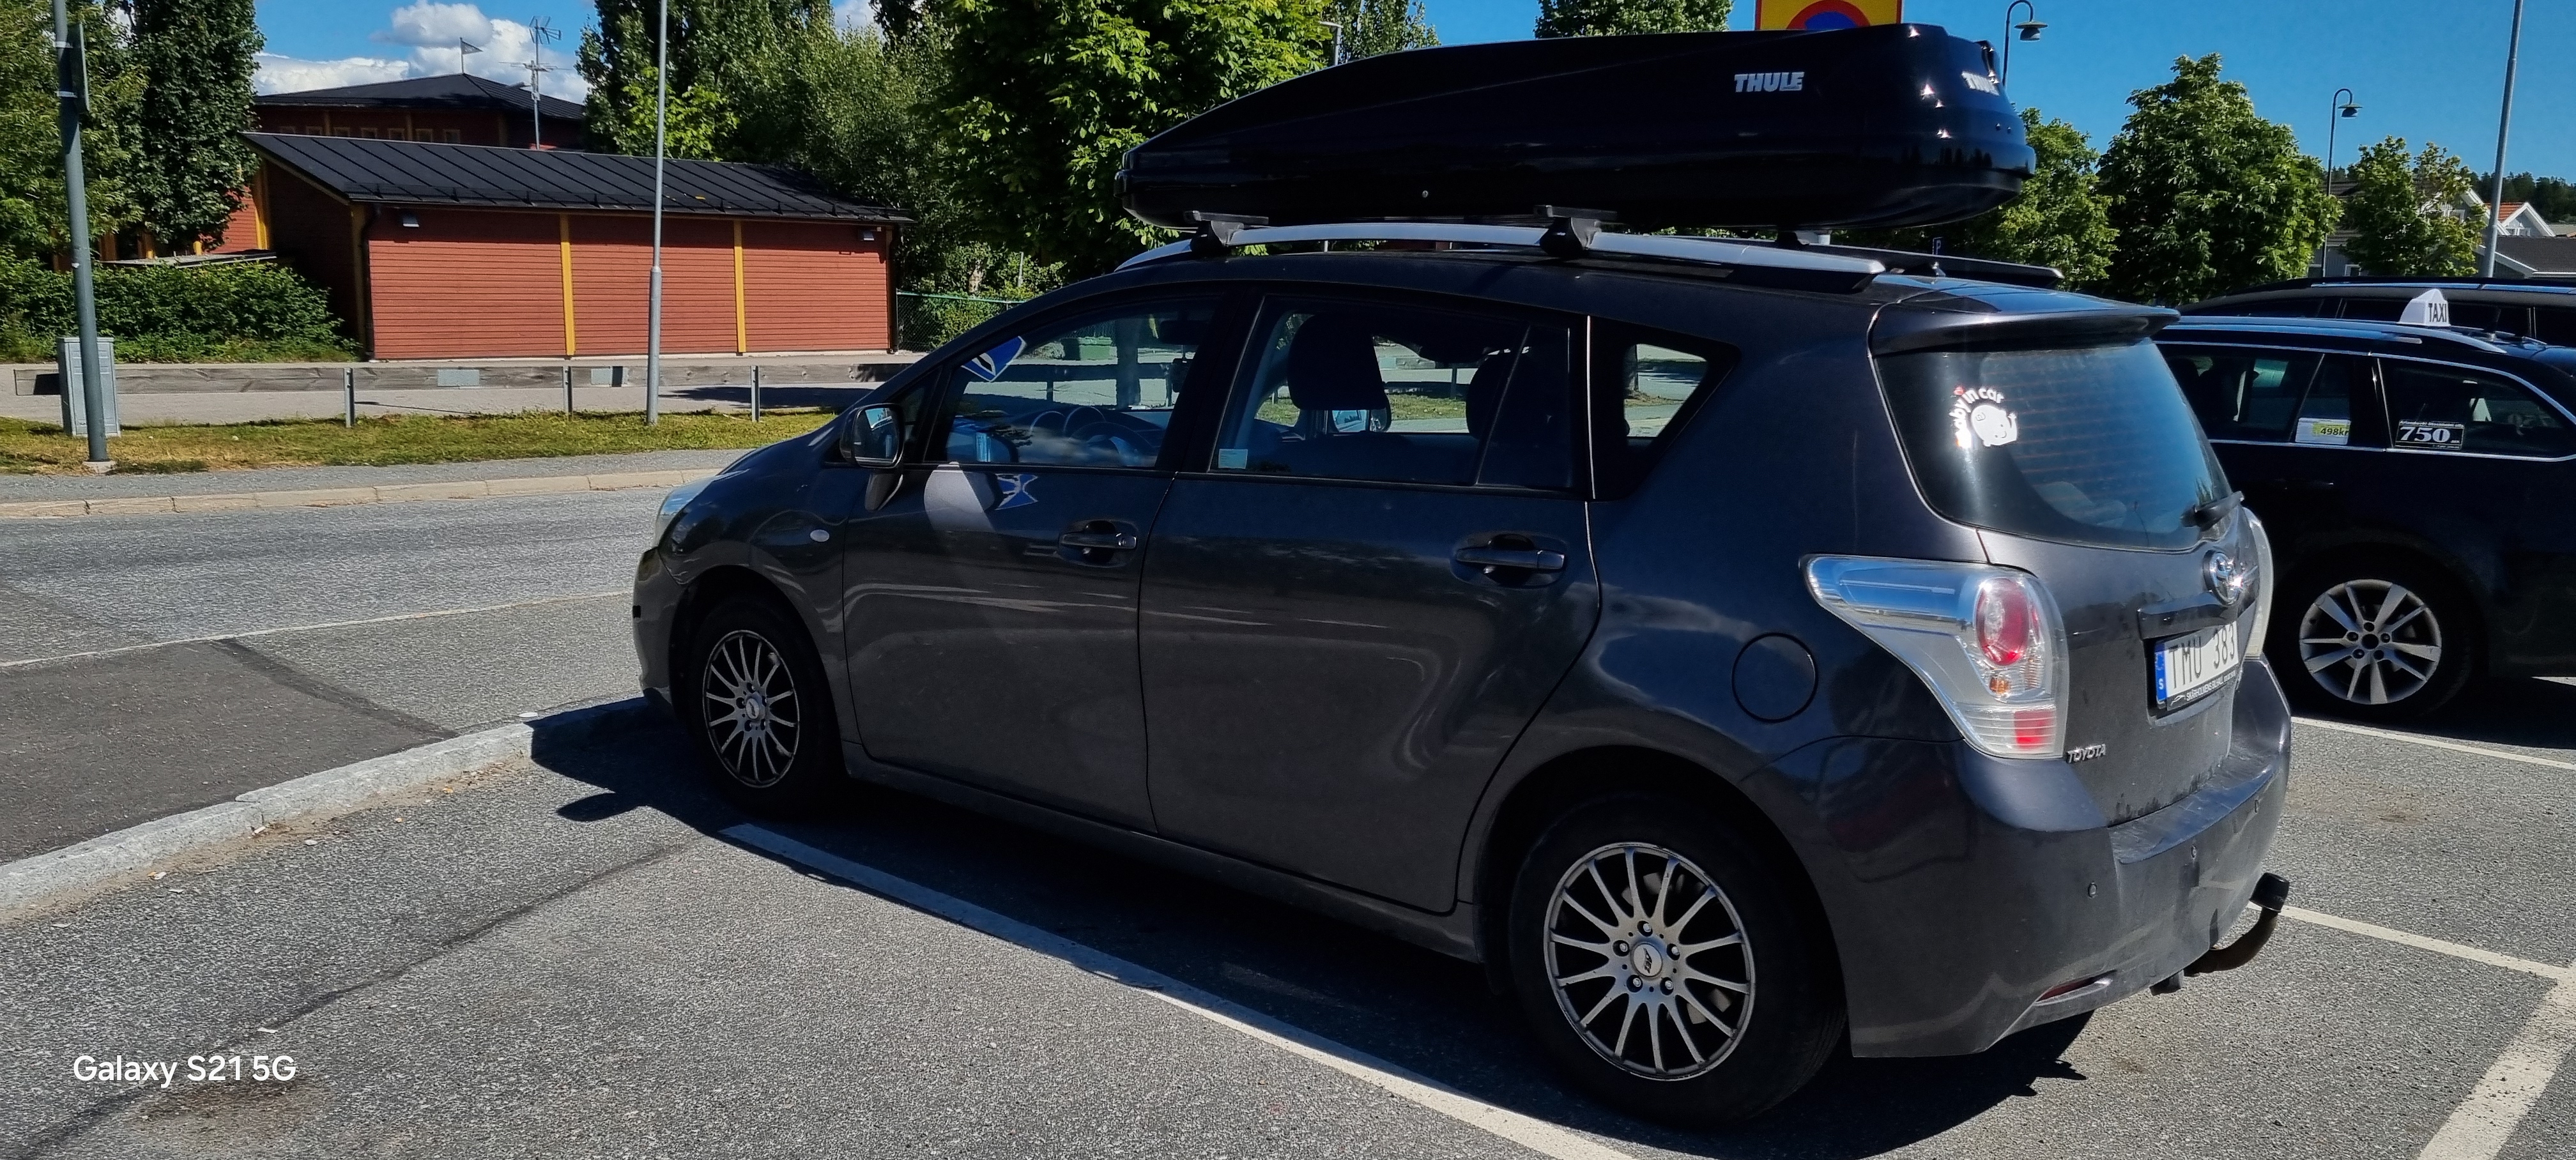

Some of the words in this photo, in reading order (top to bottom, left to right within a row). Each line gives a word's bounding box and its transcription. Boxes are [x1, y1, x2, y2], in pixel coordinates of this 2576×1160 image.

[1735, 72, 1804, 92] THULE
[2428, 303, 2447, 323] TAXI
[1979, 388, 2004, 404] car
[2320, 427, 2349, 436] 498kr
[2400, 426, 2450, 443] 750
[2168, 636, 2202, 689] TMU
[2213, 623, 2235, 669] 383
[2159, 678, 2164, 690] S
[2067, 744, 2106, 763] TOYOTA
